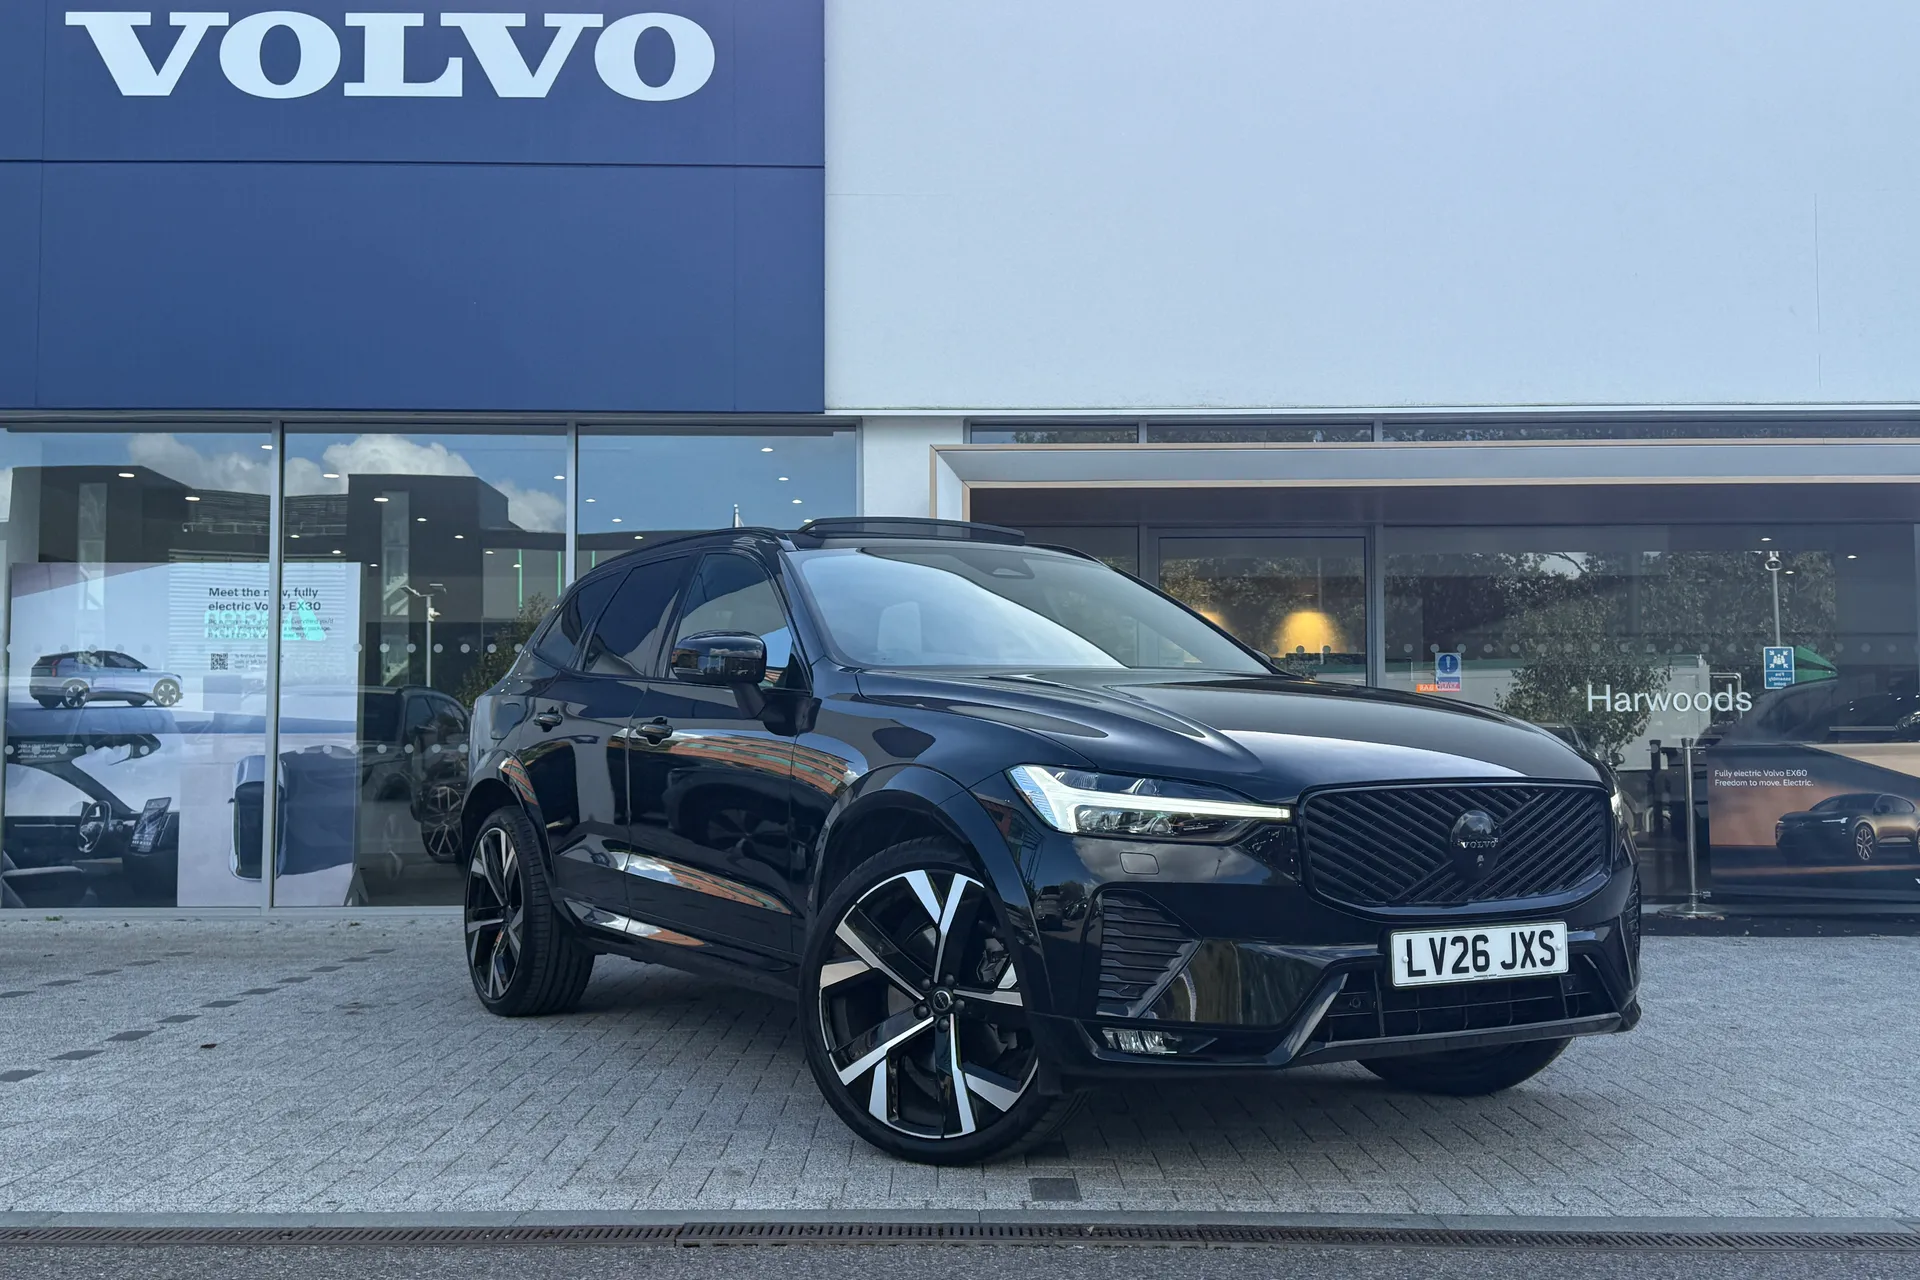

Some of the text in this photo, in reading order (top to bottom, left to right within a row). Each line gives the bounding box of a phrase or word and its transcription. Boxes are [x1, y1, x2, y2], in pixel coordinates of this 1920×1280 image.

[65, 10, 716, 101] VOLVO
[209, 587, 239, 597] Meet
[242, 587, 260, 597] the
[294, 587, 319, 599] fully
[208, 601, 251, 611] electric
[289, 601, 321, 611] EX30
[1587, 683, 1753, 712] Harwoods
[1714, 769, 1808, 779] Fully electric Volvo EX60
[1714, 779, 1748, 787] Freedom
[1749, 779, 1758, 787] to
[1783, 779, 1814, 787] Electric.
[1460, 840, 1497, 849] VOLVO
[1406, 929, 1556, 978] LV26 JXS
